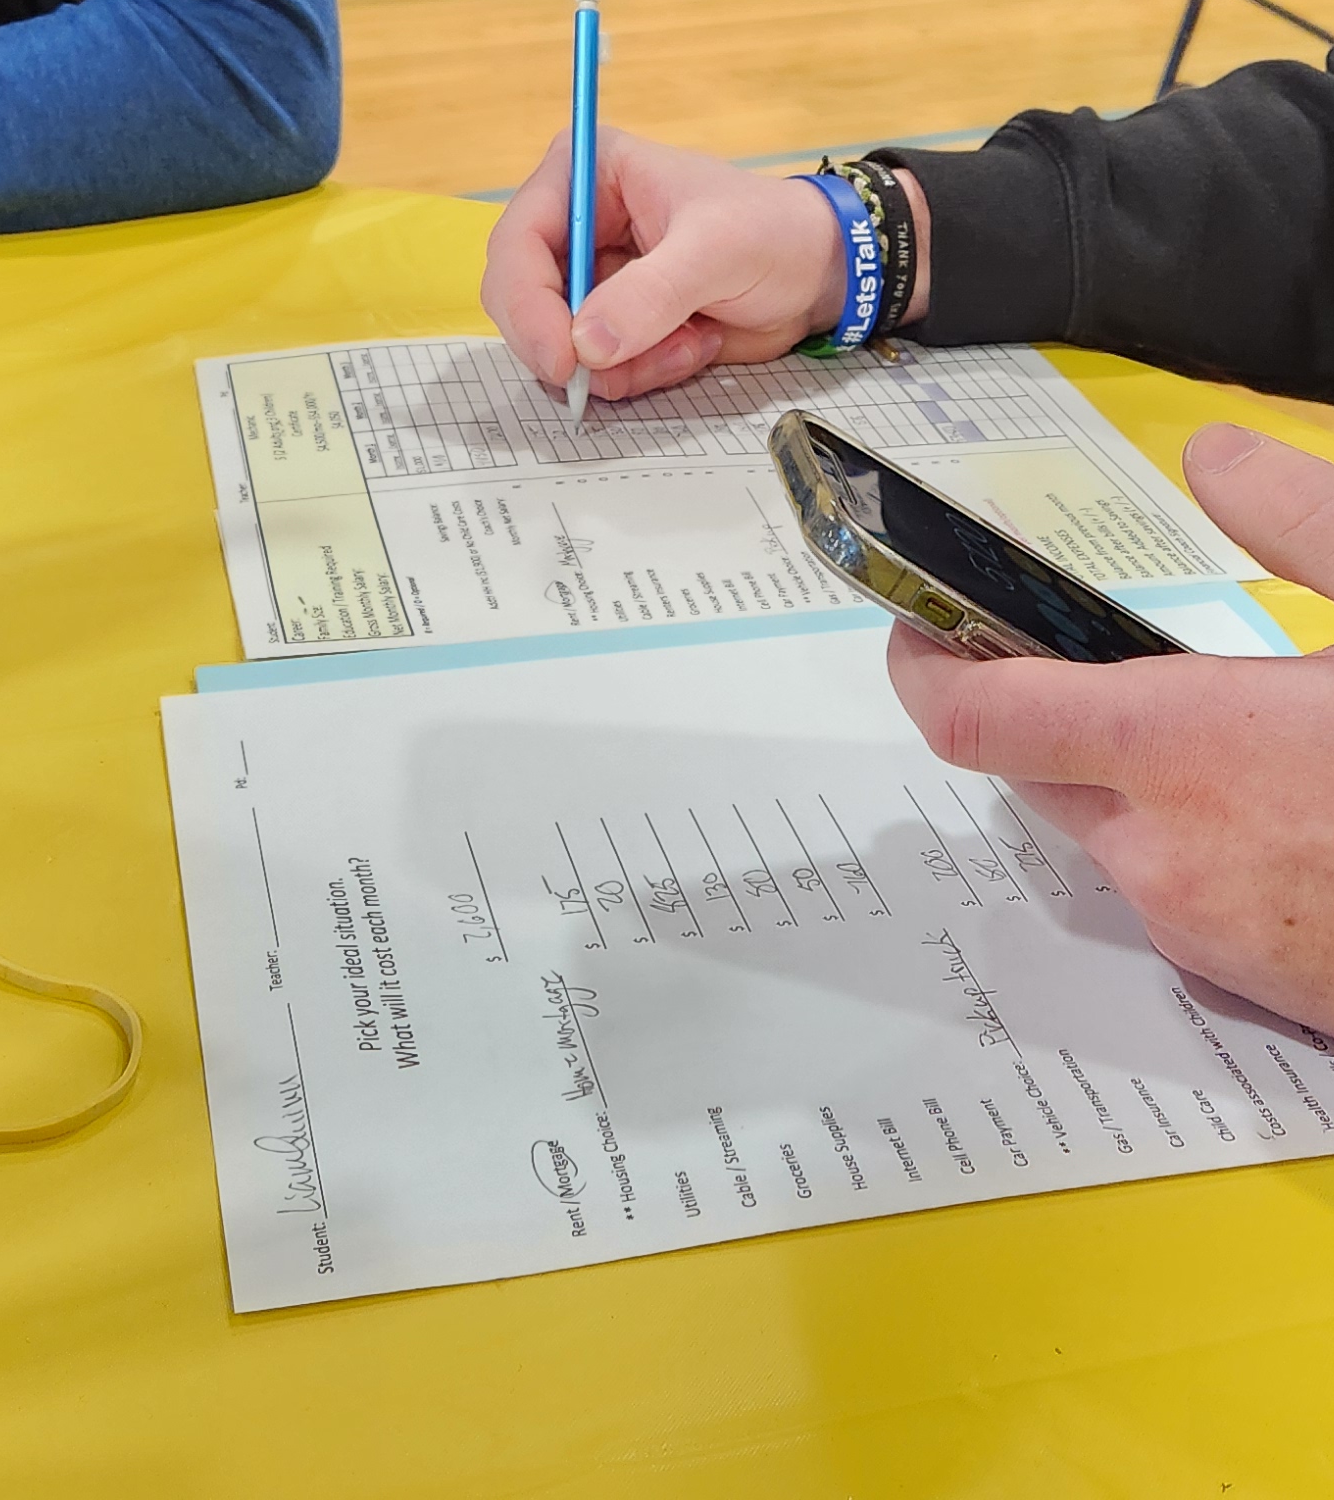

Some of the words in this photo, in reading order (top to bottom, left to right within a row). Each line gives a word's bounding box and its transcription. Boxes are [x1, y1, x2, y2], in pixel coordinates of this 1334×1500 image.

[896, 221, 911, 268] THANK
[841, 219, 877, 344] #LetsTalk
[893, 273, 909, 299] YOU
[287, 410, 303, 436] Certificate
[1044, 492, 1068, 512] month
[1094, 499, 1122, 521] Savings
[1064, 512, 1096, 538] previous
[1128, 512, 1162, 534] savings
[1036, 535, 1068, 562] INCOME
[1053, 529, 1090, 560] EXPENSES
[1088, 539, 1108, 555] from
[1109, 538, 1130, 554] after
[1121, 529, 1148, 550] Added
[1150, 535, 1171, 551] after
[319, 545, 337, 575] Required
[800, 551, 829, 589] Transportation
[1083, 561, 1106, 581] TOTAL
[1103, 556, 1132, 579] Balance
[1124, 555, 1154, 578] Balance
[1143, 552, 1173, 576] Amount
[1166, 552, 1196, 575] Balance
[329, 575, 343, 602] Training
[352, 568, 367, 590] Salary:
[377, 573, 392, 594] Salary:
[622, 570, 643, 599] Streaming
[645, 568, 664, 594] Insurance
[695, 571, 714, 594] Supplies
[767, 572, 787, 597] Payment
[792, 575, 810, 595] Vehicle
[356, 591, 374, 618] Monthly
[381, 595, 399, 623] Monthly
[582, 590, 598, 613] Housing
[612, 600, 628, 621] Utilities
[638, 604, 652, 619] Cable
[659, 595, 675, 617] Renters
[680, 588, 700, 615] Groceries
[708, 595, 721, 613] House
[728, 588, 746, 611] Internet
[290, 619, 305, 641] Career:
[314, 619, 334, 640] Family
[337, 607, 356, 638] Education
[366, 618, 381, 637] Gross
[391, 623, 404, 635] Net
[234, 776, 247, 788] Pd:
[347, 857, 380, 906] month?
[702, 869, 730, 901] 130
[791, 864, 824, 891] 50
[541, 868, 588, 915] 175
[593, 880, 624, 912] 20
[326, 877, 356, 940] situation.
[776, 917, 797, 926] $
[822, 911, 841, 921] $
[869, 906, 888, 915] $
[360, 911, 389, 943] each
[728, 922, 746, 931] $
[335, 944, 365, 978] ideal
[371, 947, 397, 976] cost
[921, 929, 973, 985] truck
[265, 950, 282, 991] Teacher:
[378, 979, 400, 989] it
[350, 982, 379, 1016] your
[379, 994, 408, 1020] will
[1171, 987, 1205, 1026] Children
[353, 1019, 382, 1050] Pick
[390, 1023, 420, 1068] What
[1199, 1027, 1223, 1050] with
[1012, 1060, 1042, 1097] Choice:
[1214, 1052, 1264, 1105] associated
[1265, 1044, 1308, 1093] Insurance
[1058, 1049, 1113, 1124] Transportation
[922, 1098, 942, 1114] Bill
[1130, 1077, 1171, 1127] Insurance
[1192, 1089, 1215, 1113] Care
[595, 1111, 618, 1152] Choice:
[819, 1106, 849, 1152] Supplies
[876, 1117, 897, 1134] Bill
[979, 1098, 1017, 1145] Payment
[1036, 1099, 1067, 1138] Vehicle
[1206, 1115, 1235, 1141] Child
[1258, 1107, 1286, 1138] Costs
[707, 1106, 739, 1164] Streaming
[936, 1116, 963, 1151] Phone
[1112, 1133, 1133, 1153] Gas
[1164, 1129, 1184, 1147] Car
[543, 1137, 577, 1197] Mortgage
[888, 1136, 922, 1182] Internet
[952, 1153, 975, 1174] Cell
[1009, 1147, 1028, 1166] Car
[609, 1153, 635, 1202] Housing
[779, 1143, 812, 1198] Groceries
[842, 1154, 867, 1190] House
[559, 1196, 580, 1204] /
[674, 1171, 700, 1217] Utilities
[733, 1174, 756, 1207] Cable
[566, 1207, 586, 1236] Rent
[311, 1221, 334, 1274] Student:
